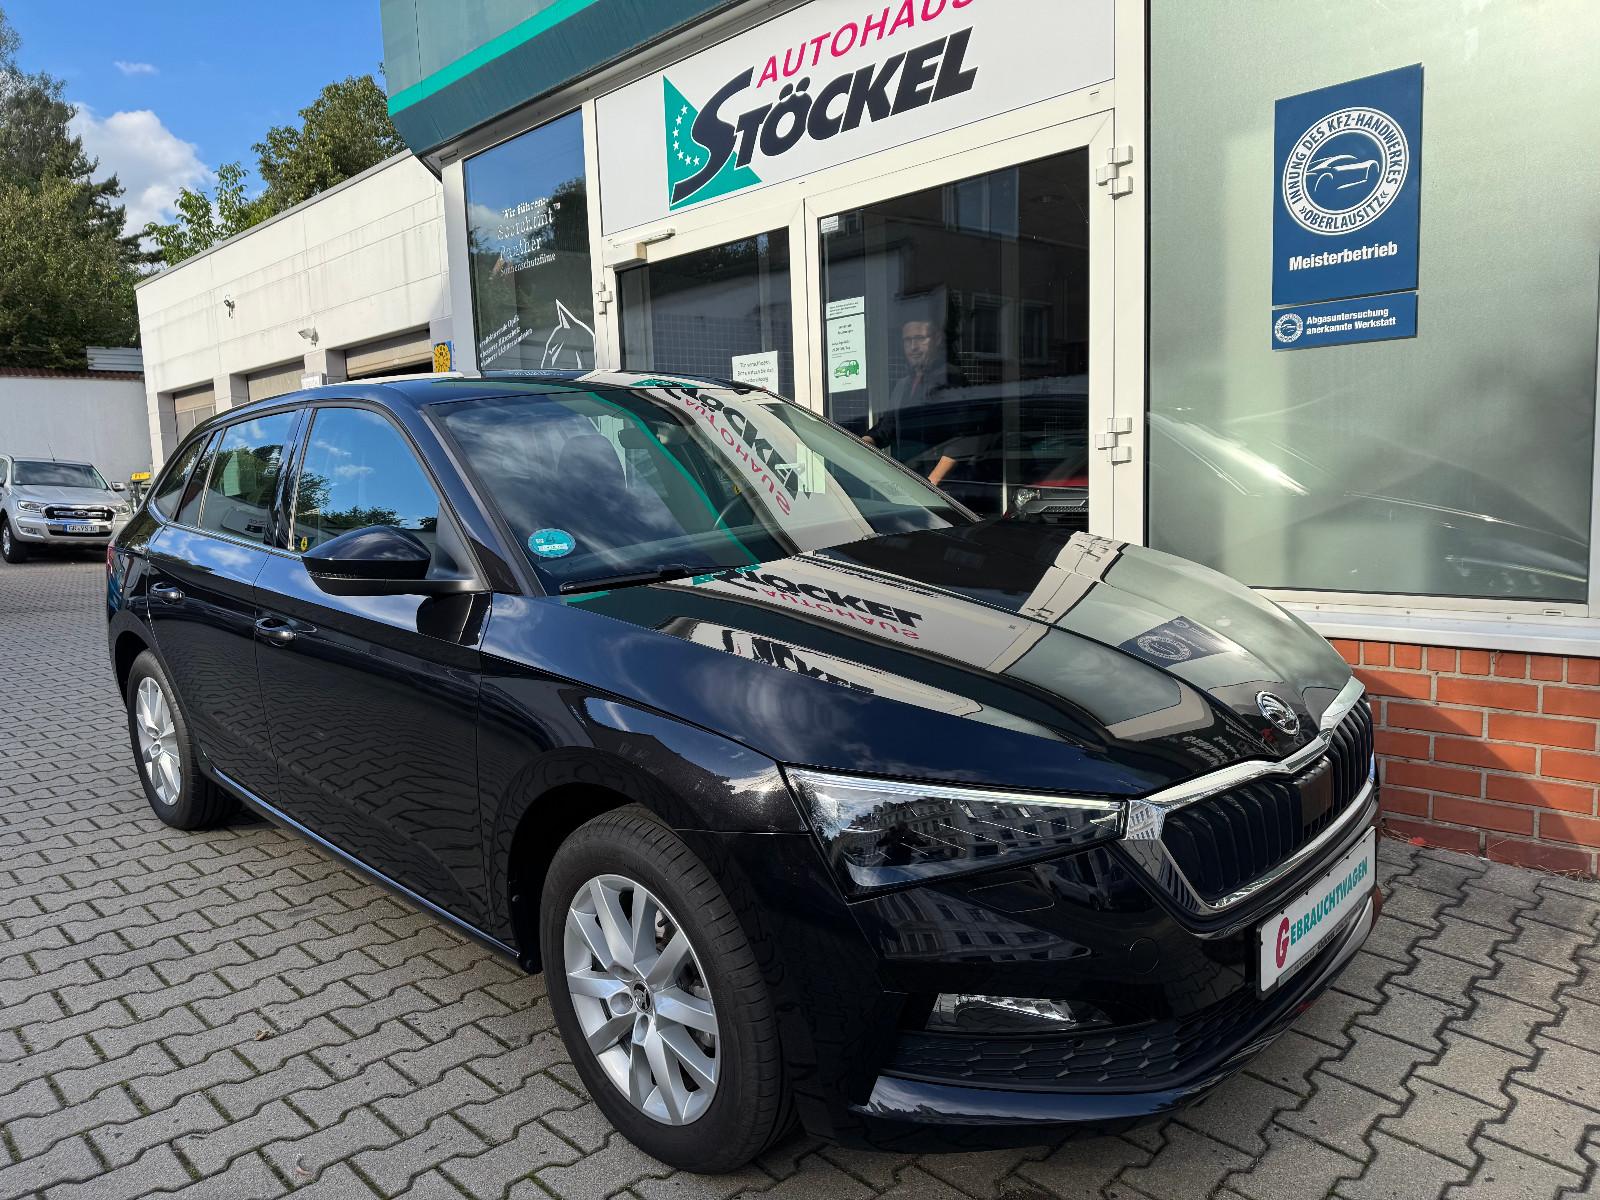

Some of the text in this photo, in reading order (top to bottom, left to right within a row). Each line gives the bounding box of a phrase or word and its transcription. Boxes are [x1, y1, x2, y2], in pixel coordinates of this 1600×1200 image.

[671, 26, 978, 204] STÖCKEL
[1288, 112, 1403, 205] INNUNG DES KFZ-HANDWERKES
[502, 207, 516, 219] Wir
[1289, 241, 1398, 271] Meisterbetrieb
[1306, 308, 1389, 325] Abgasuntersuchung
[1306, 323, 1352, 335] anerkannte
[1354, 316, 1397, 330] Werkstatt
[1275, 856, 1368, 969] GEBRAUCHTWAGEN
